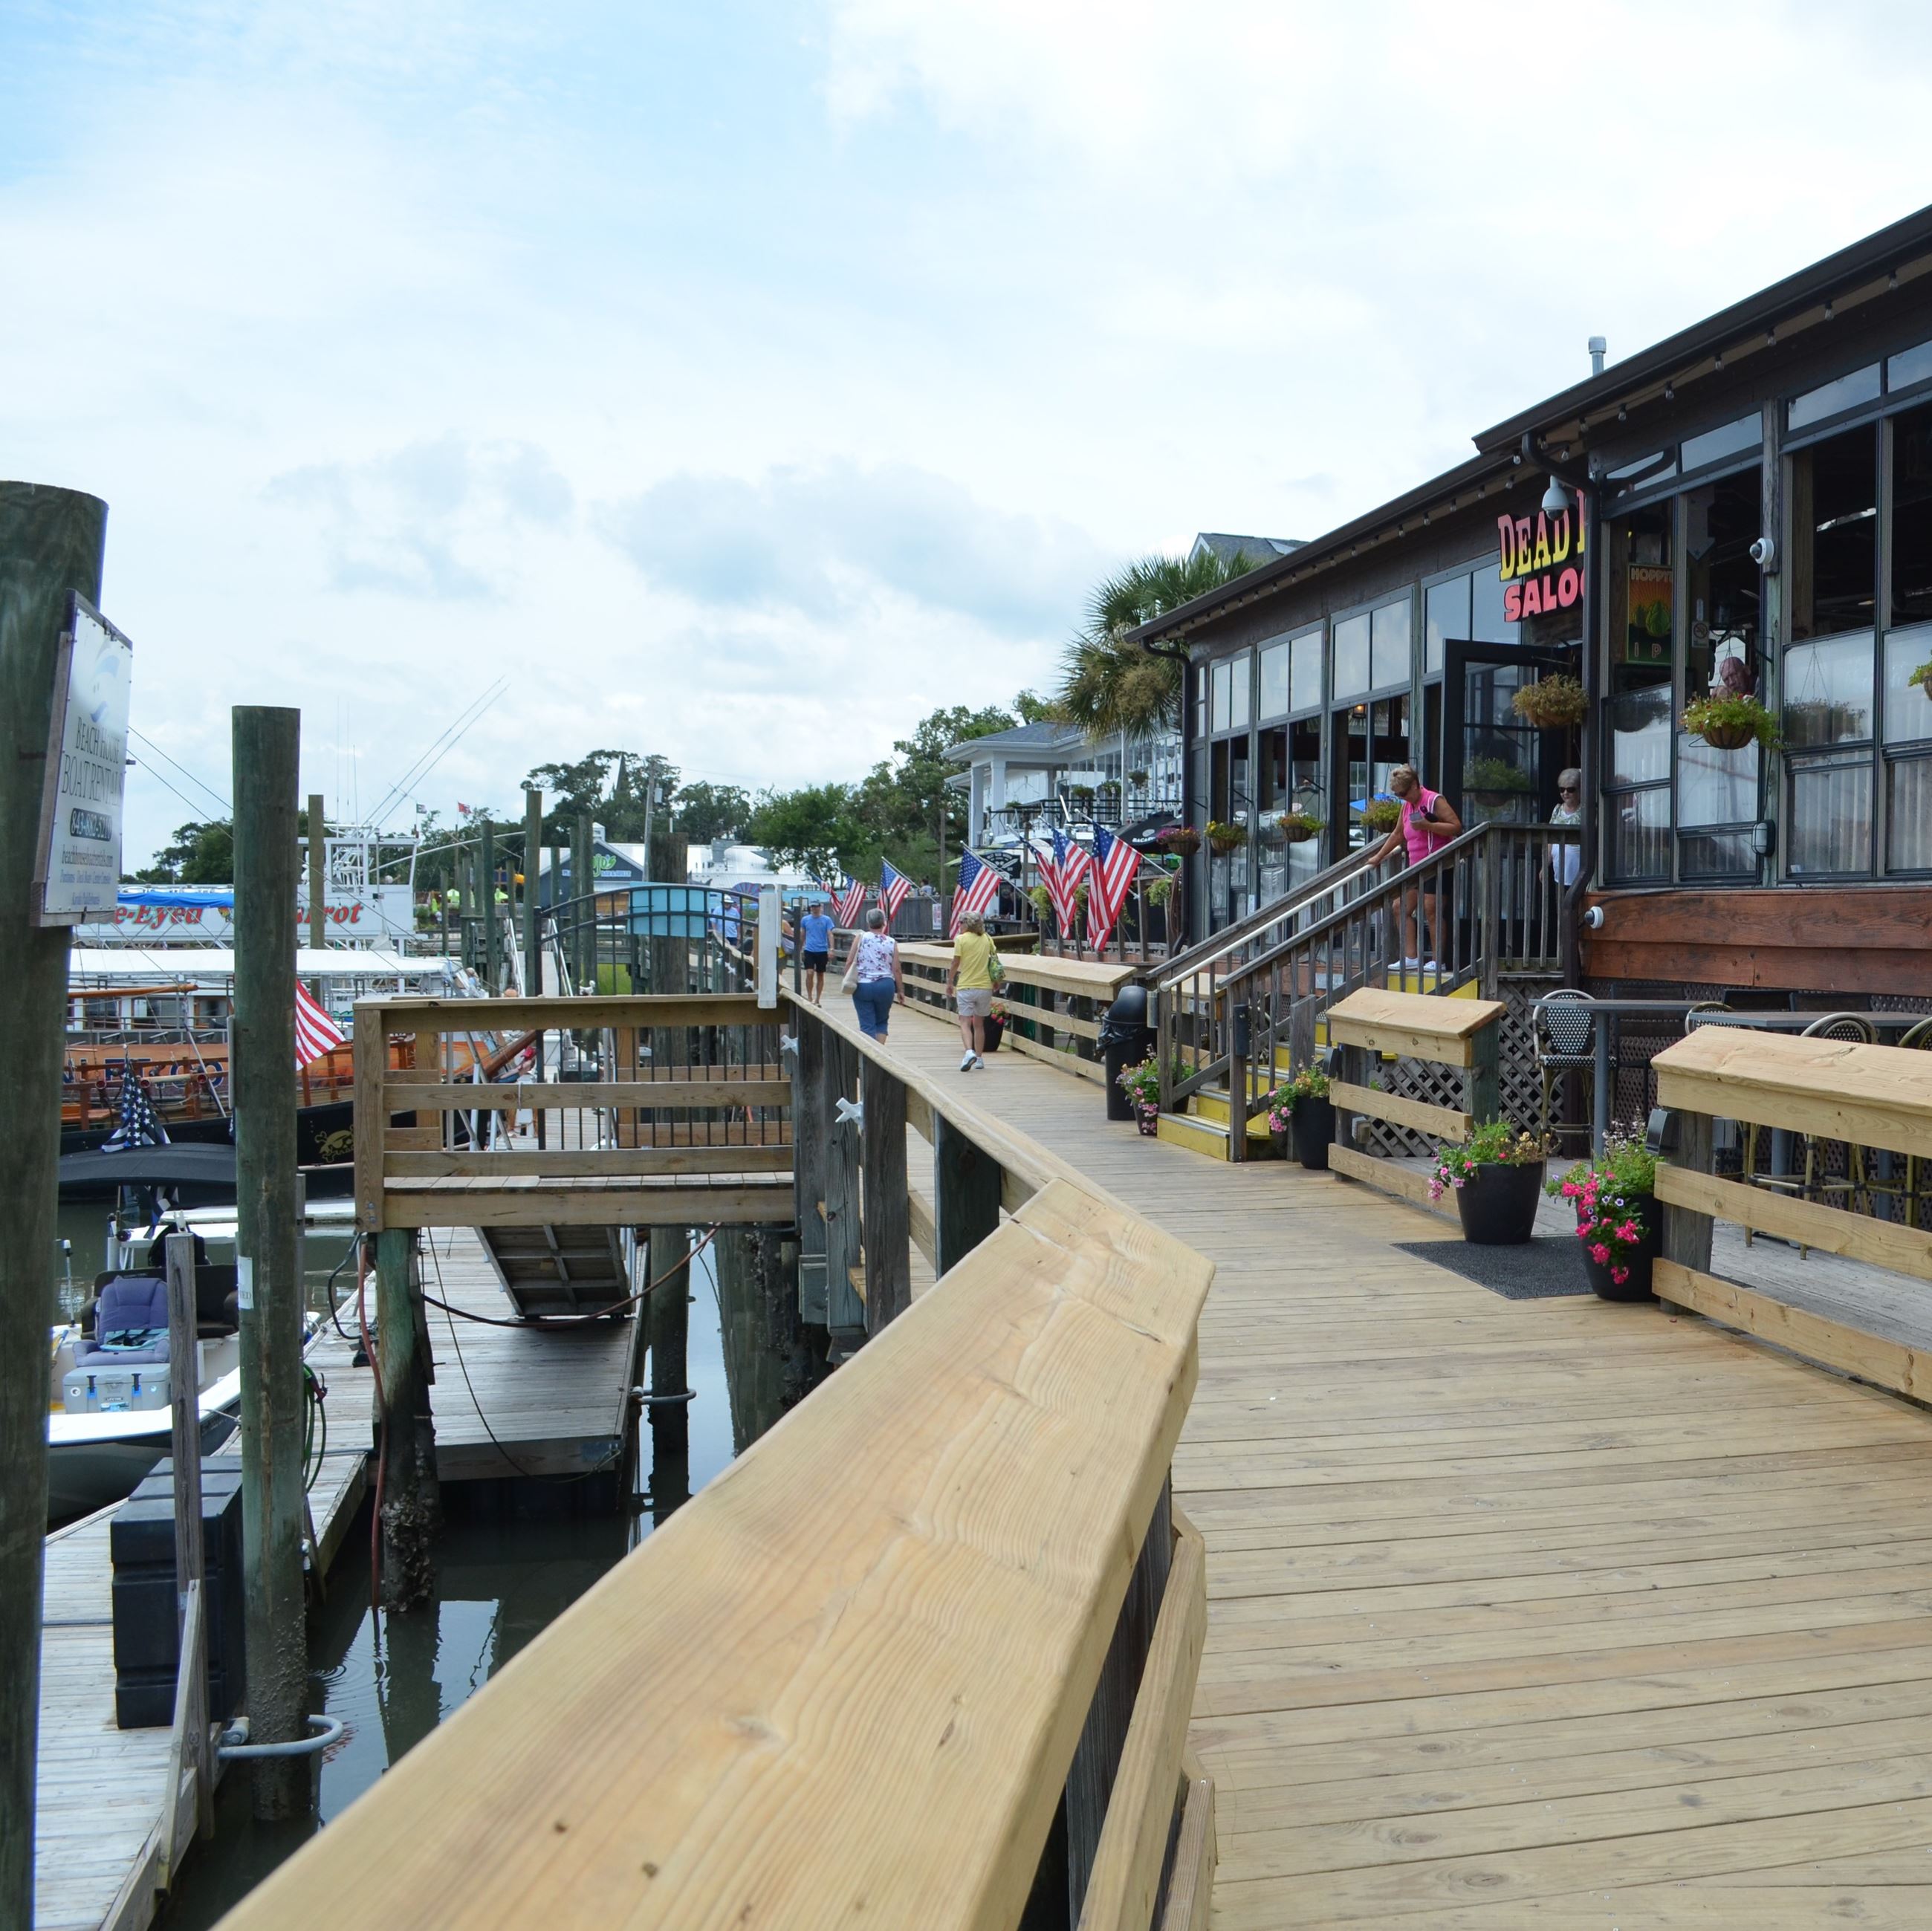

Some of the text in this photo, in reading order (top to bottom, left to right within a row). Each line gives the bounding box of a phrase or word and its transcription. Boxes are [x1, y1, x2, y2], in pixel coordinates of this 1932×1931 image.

[1497, 509, 1570, 582] DEAD
[1504, 568, 1585, 623] SALO
[76, 716, 100, 756] BEACH
[61, 754, 90, 799] BOAT
